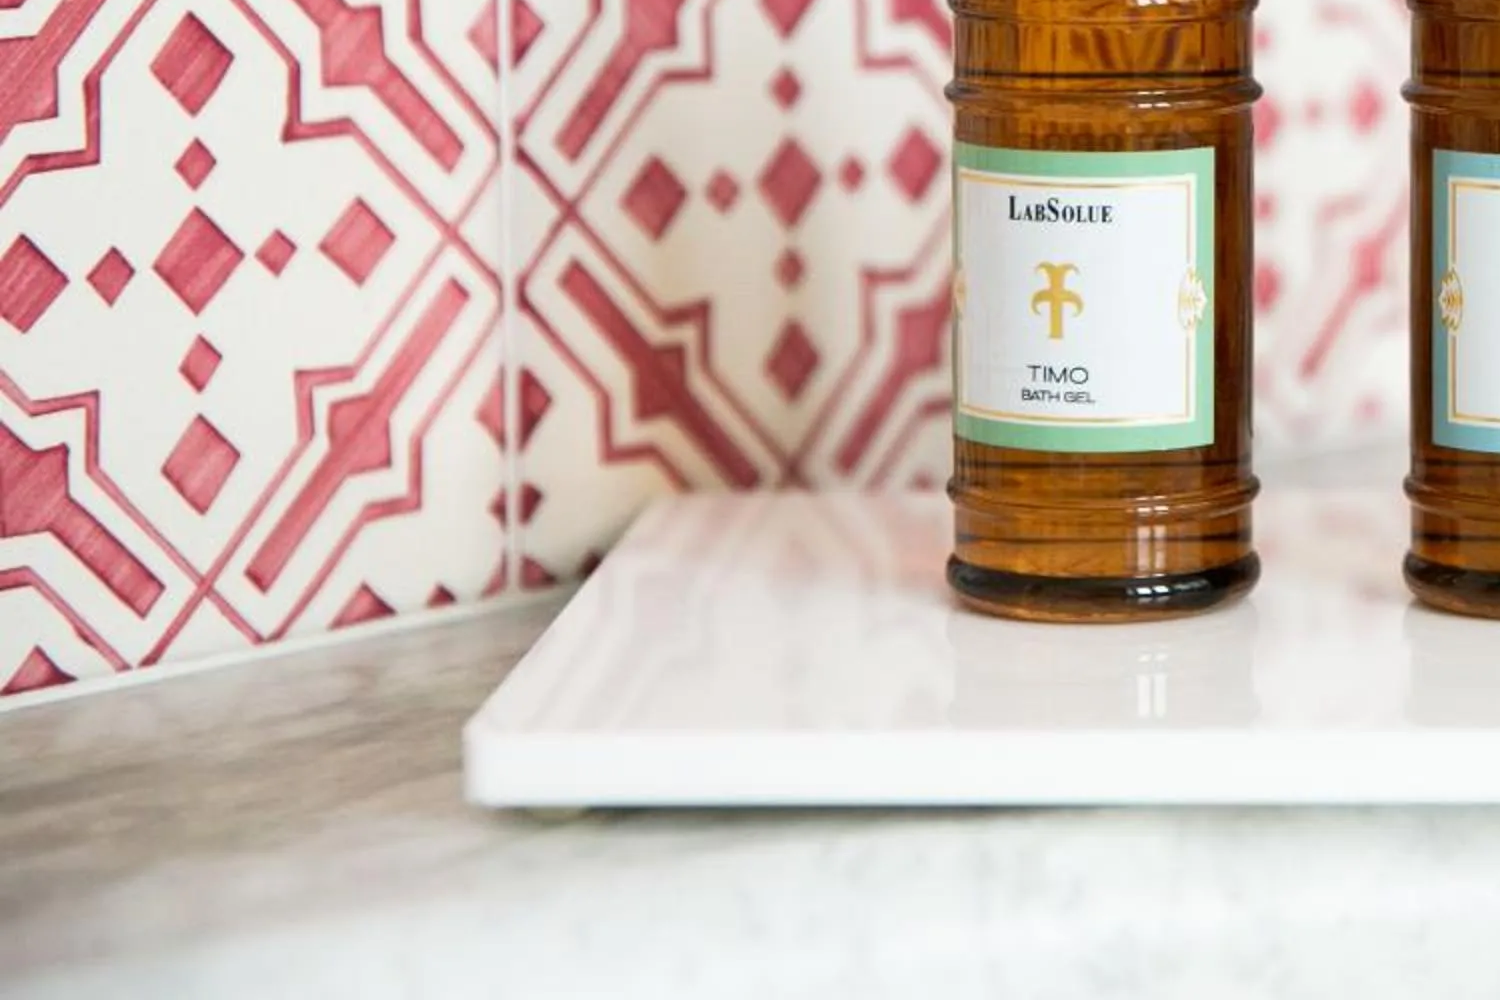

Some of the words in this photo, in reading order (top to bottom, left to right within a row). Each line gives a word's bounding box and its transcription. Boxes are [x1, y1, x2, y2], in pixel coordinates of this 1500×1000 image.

[1026, 365, 1089, 385] TIMO
[1021, 388, 1061, 402] BATH
[1064, 391, 1095, 404] GEL
